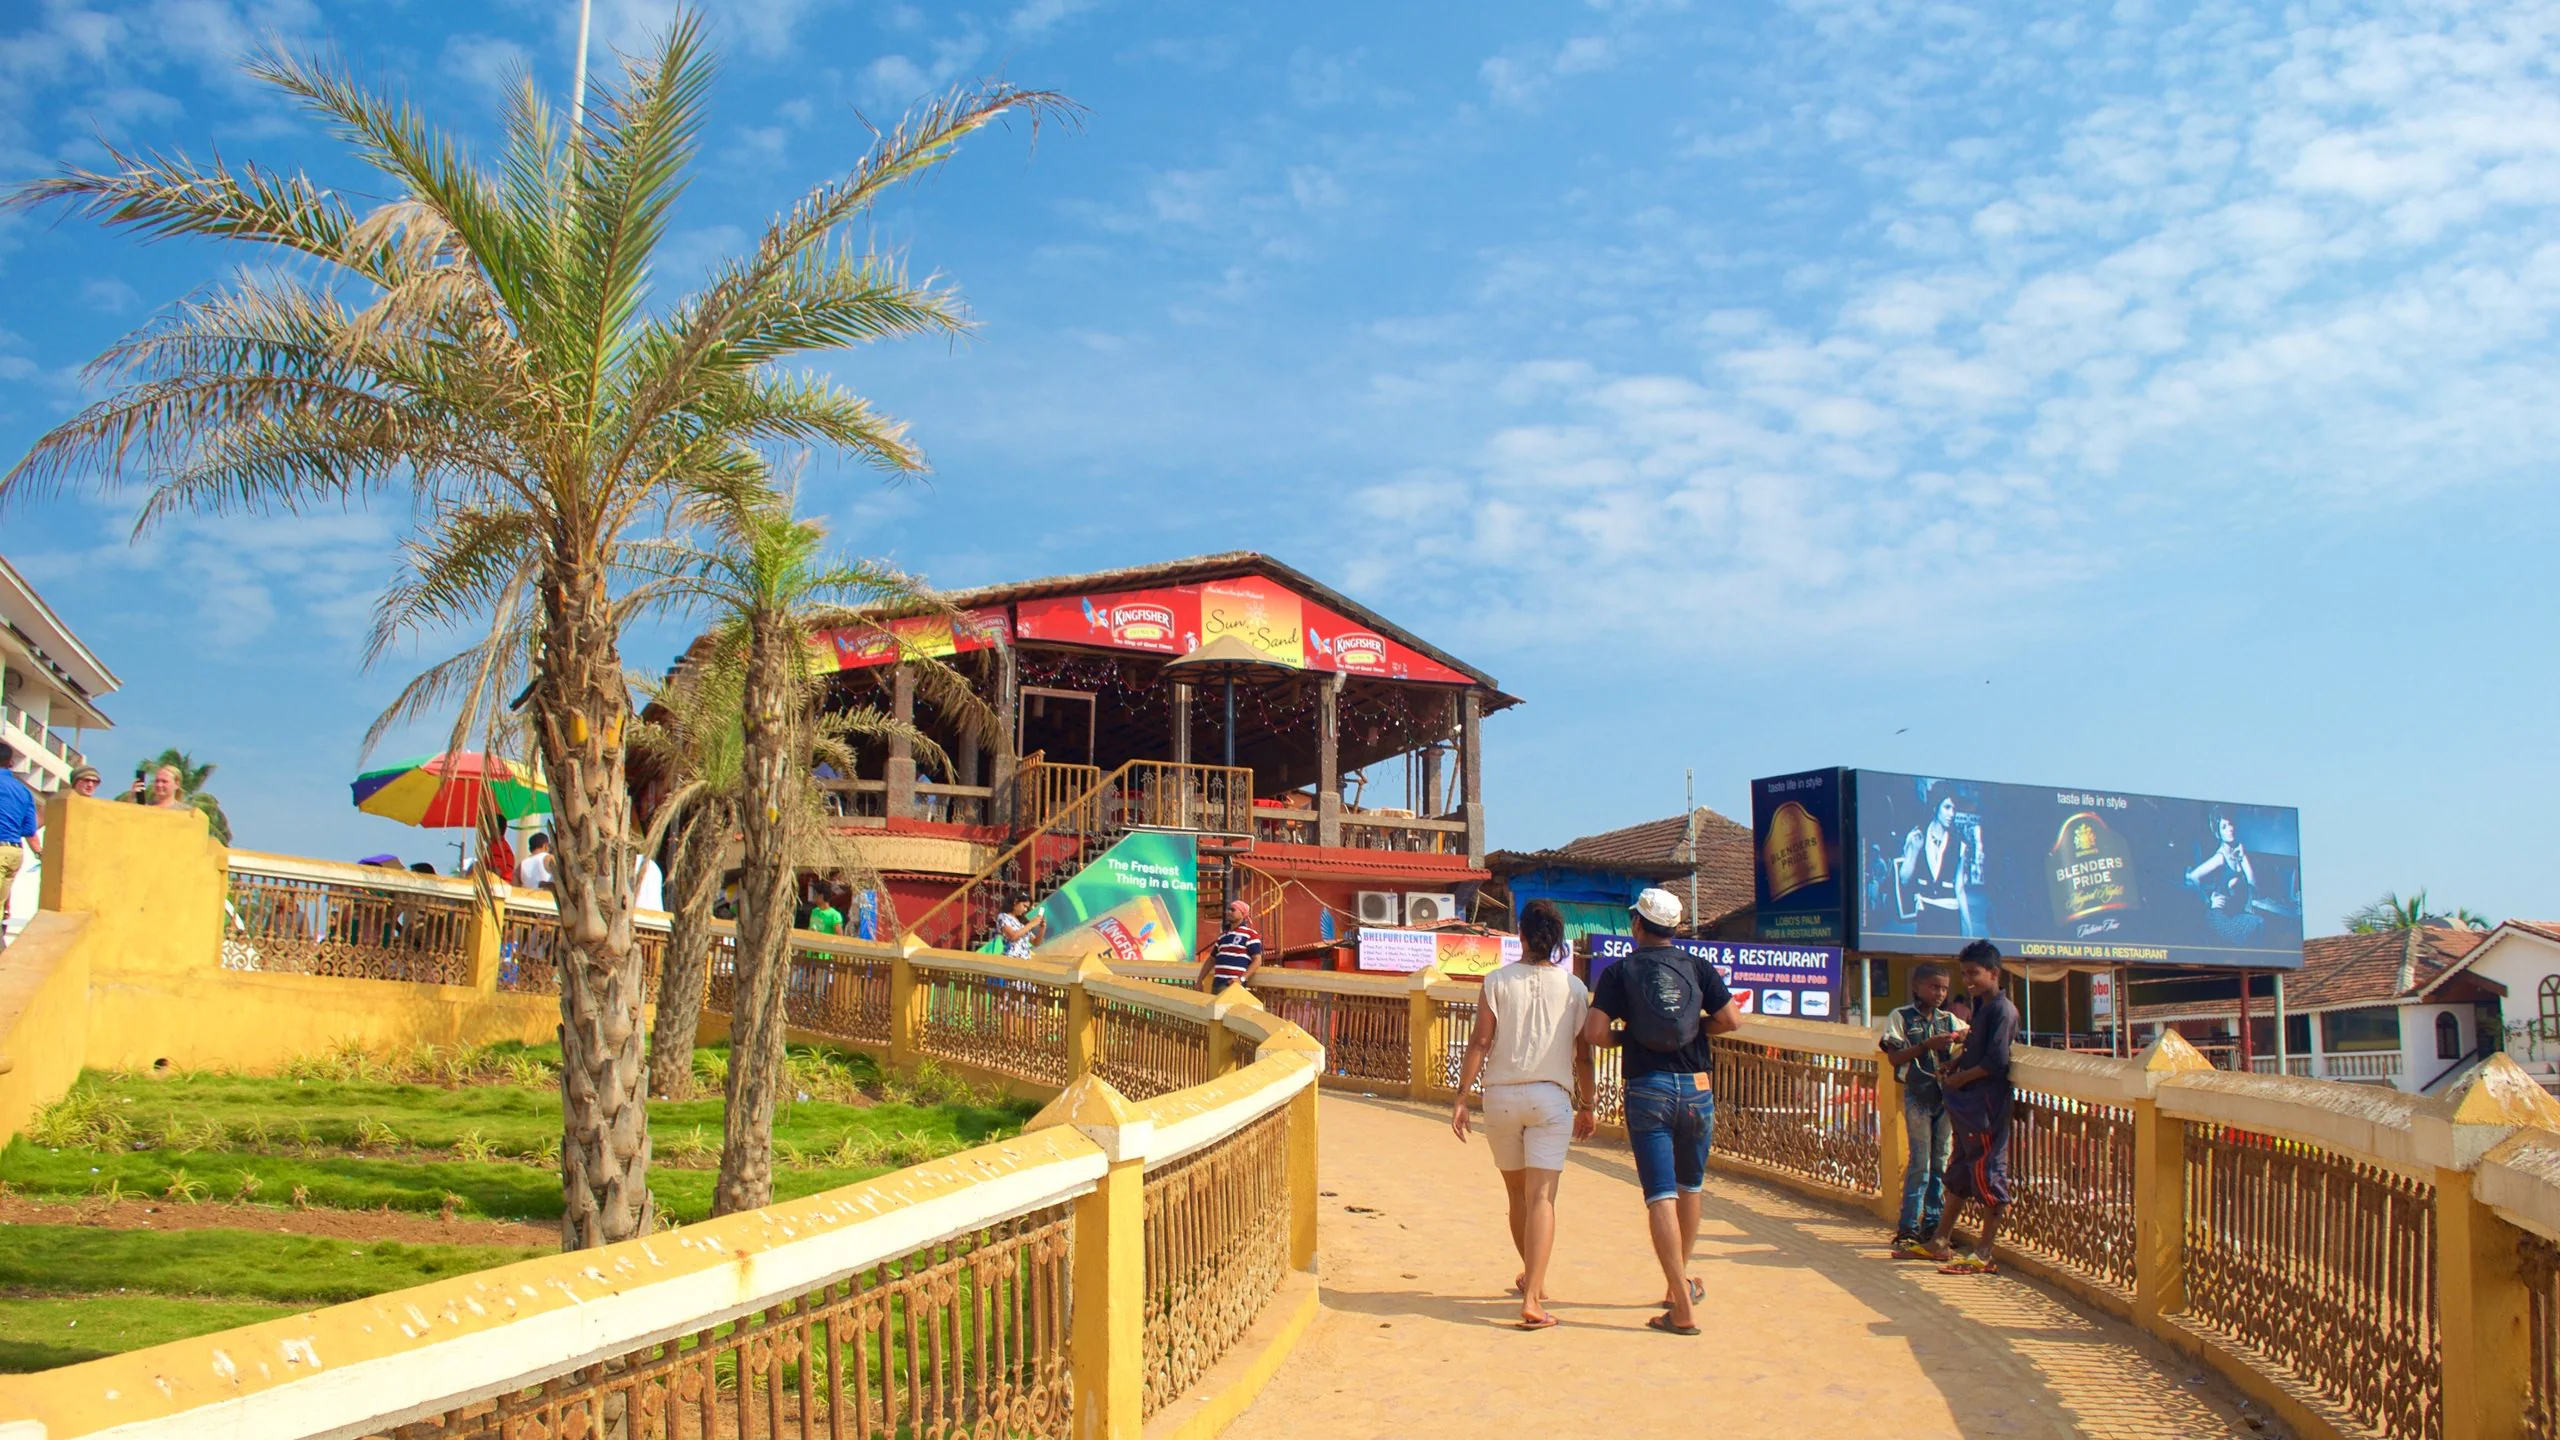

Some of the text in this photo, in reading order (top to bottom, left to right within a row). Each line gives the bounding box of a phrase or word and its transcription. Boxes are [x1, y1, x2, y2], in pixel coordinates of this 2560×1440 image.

[1114, 608, 1171, 628] KINGFISHER
[1206, 609, 1247, 634] Sun
[1252, 627, 1299, 652] Sand
[1336, 637, 1383, 654] KINGFISHER
[1767, 775, 1823, 793] taste life in style
[2057, 792, 2127, 811] taste life in style
[1770, 837, 1818, 865] BLENDERS
[1108, 858, 1179, 876] The Freshest
[1781, 851, 1809, 870] PRIDE
[2056, 857, 2123, 882] BLENDERS
[1116, 873, 1196, 891] Thing in a Can.
[2072, 871, 2111, 890] PRIDE
[1775, 914, 1821, 927] LOBO'S PALM
[1098, 917, 1139, 960] KINGFIS
[1363, 931, 1433, 945] BHELPURI CENTRE
[1765, 929, 1781, 939] PUB
[1787, 927, 1832, 939] RESTAURANT
[1439, 944, 1466, 962] Sun
[1504, 939, 1520, 949] FRUI
[2020, 943, 2168, 960] LOBO'S PALM PUB & RESTAURANT
[1468, 953, 1499, 972] Sand
[1603, 940, 1829, 968] SEA BAR & RESTAURANT
[1733, 971, 1828, 985] SPECIALLY FOR SEA FOOD
